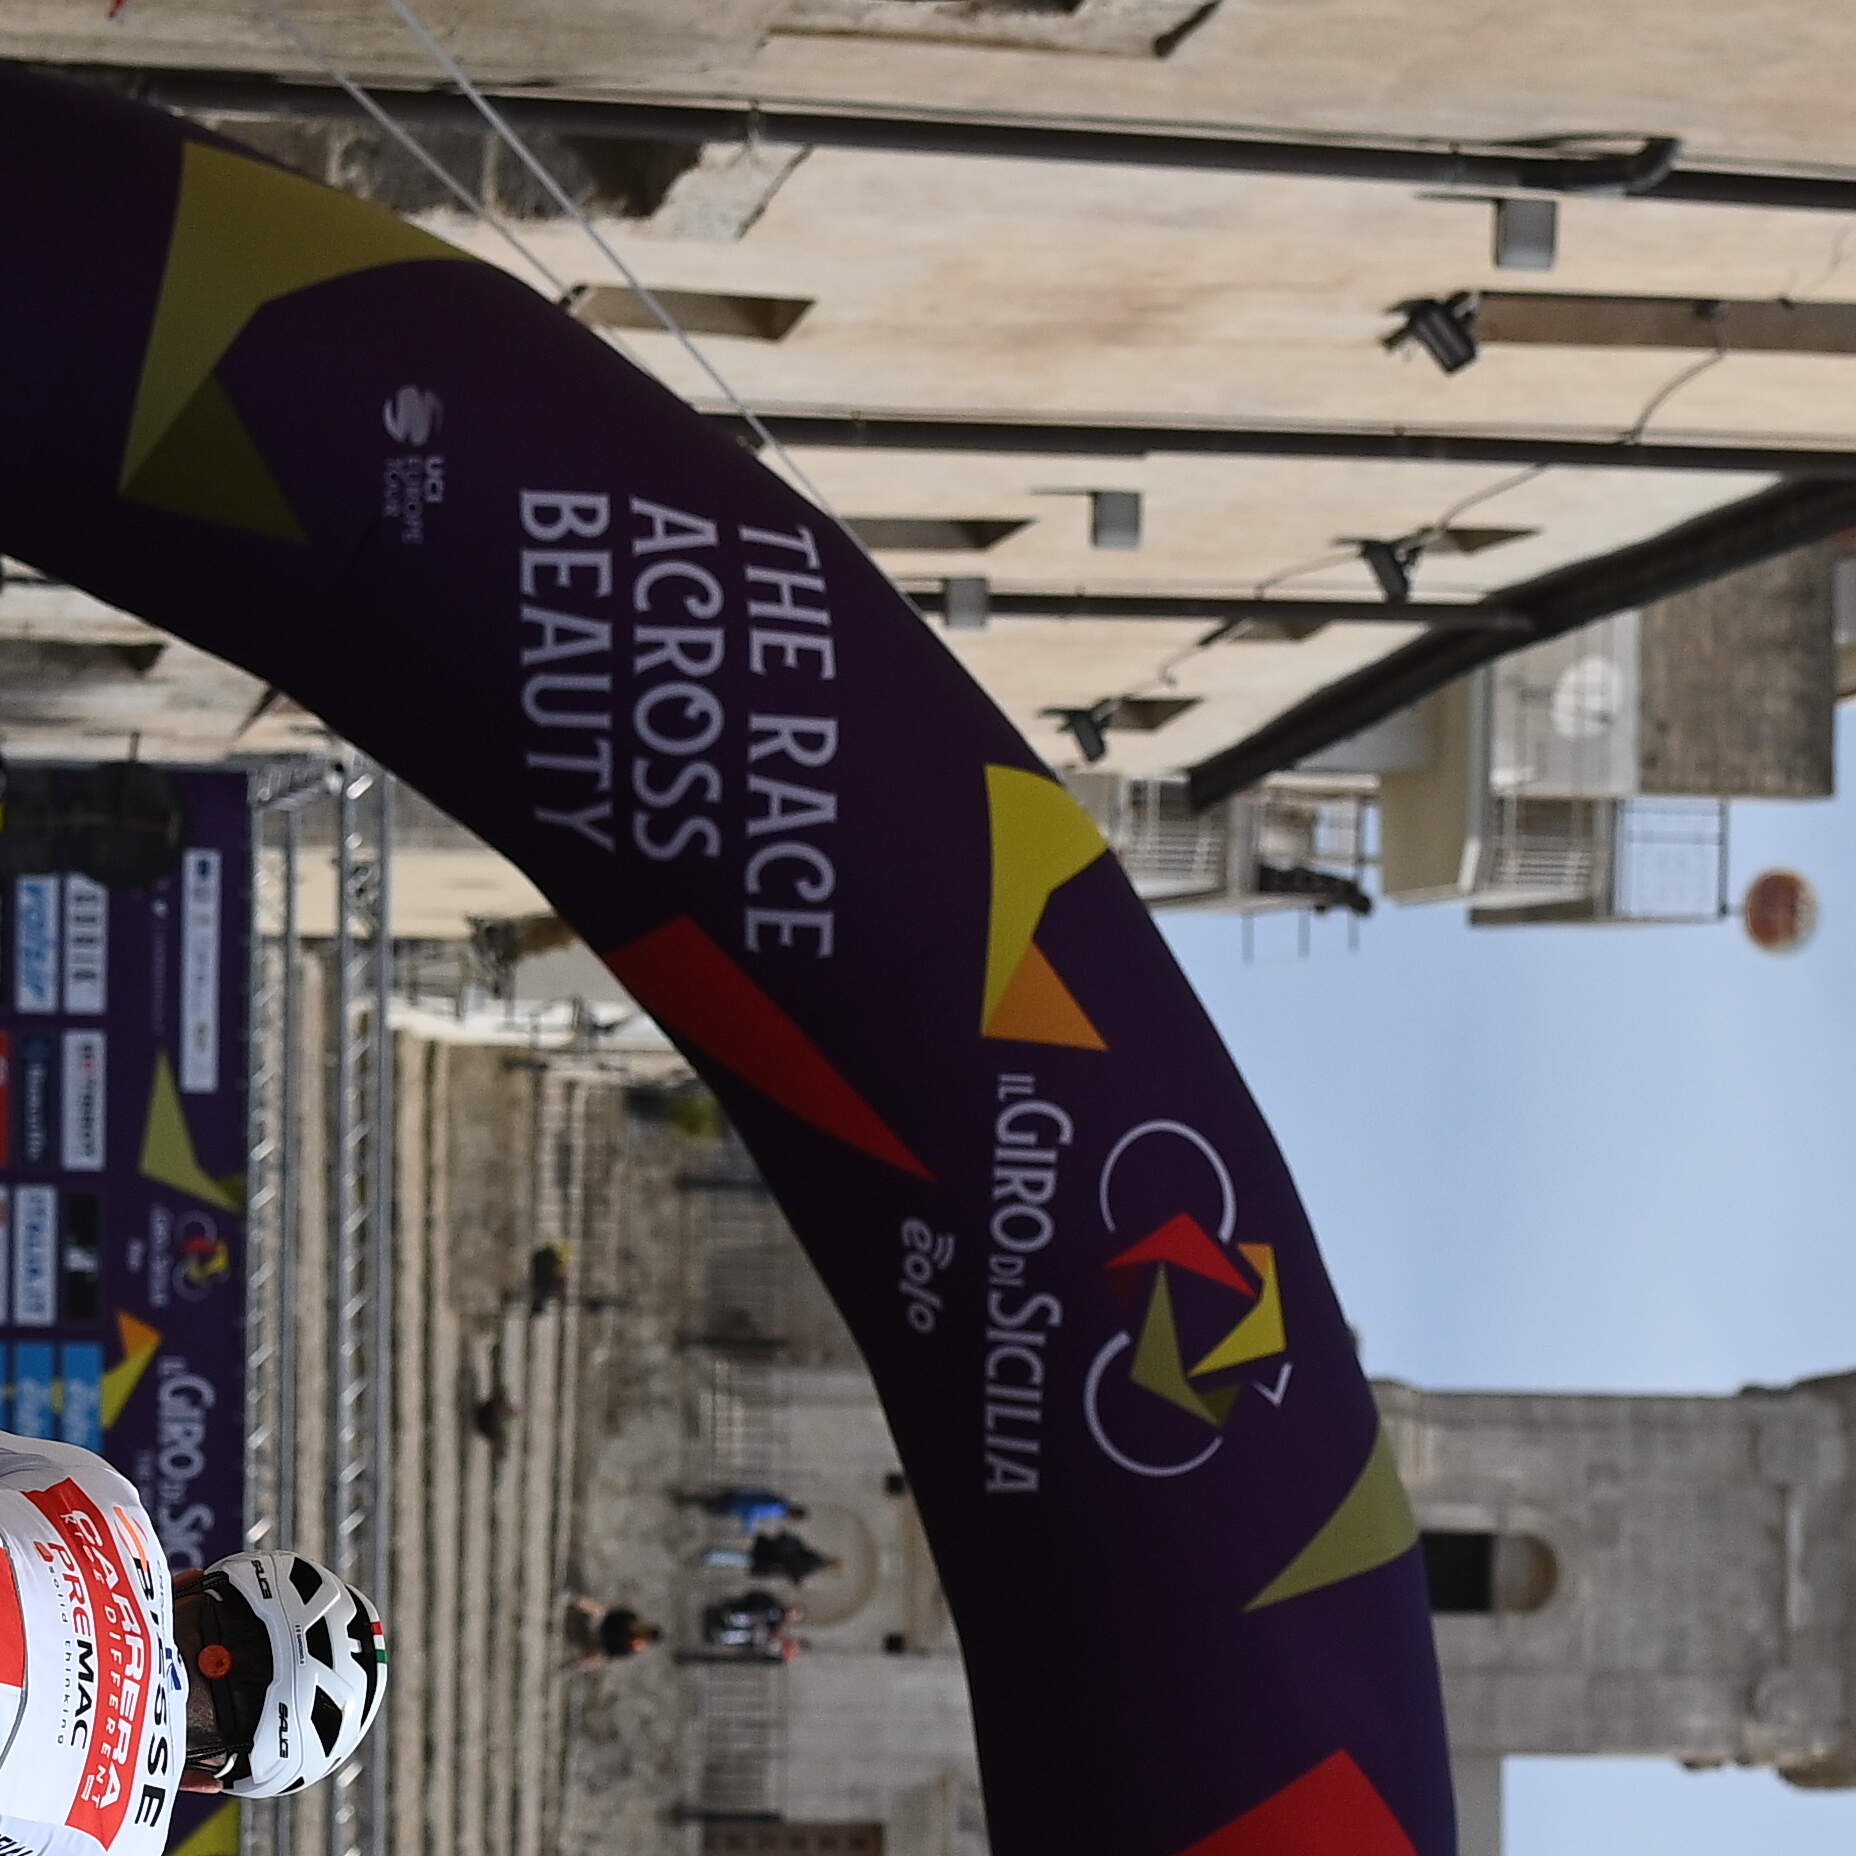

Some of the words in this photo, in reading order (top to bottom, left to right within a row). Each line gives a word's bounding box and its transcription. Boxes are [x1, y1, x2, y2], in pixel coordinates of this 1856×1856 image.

[423, 455, 444, 504] UCI
[518, 487, 616, 853] BEAUTY
[629, 495, 726, 862] ACROSS
[736, 523, 836, 682] THE
[743, 713, 839, 960] RACE
[989, 1100, 1075, 1255] GIRO
[156, 1374, 216, 1480] GIRO
[982, 1291, 1064, 1498] SICILIA
[47, 1541, 95, 1751] PREMAC
[48, 1565, 69, 1624] solid
[56, 1640, 72, 1745] thinking
[70, 1510, 145, 1809] CARRERA
[90, 1605, 123, 1810] DIFFERENT
